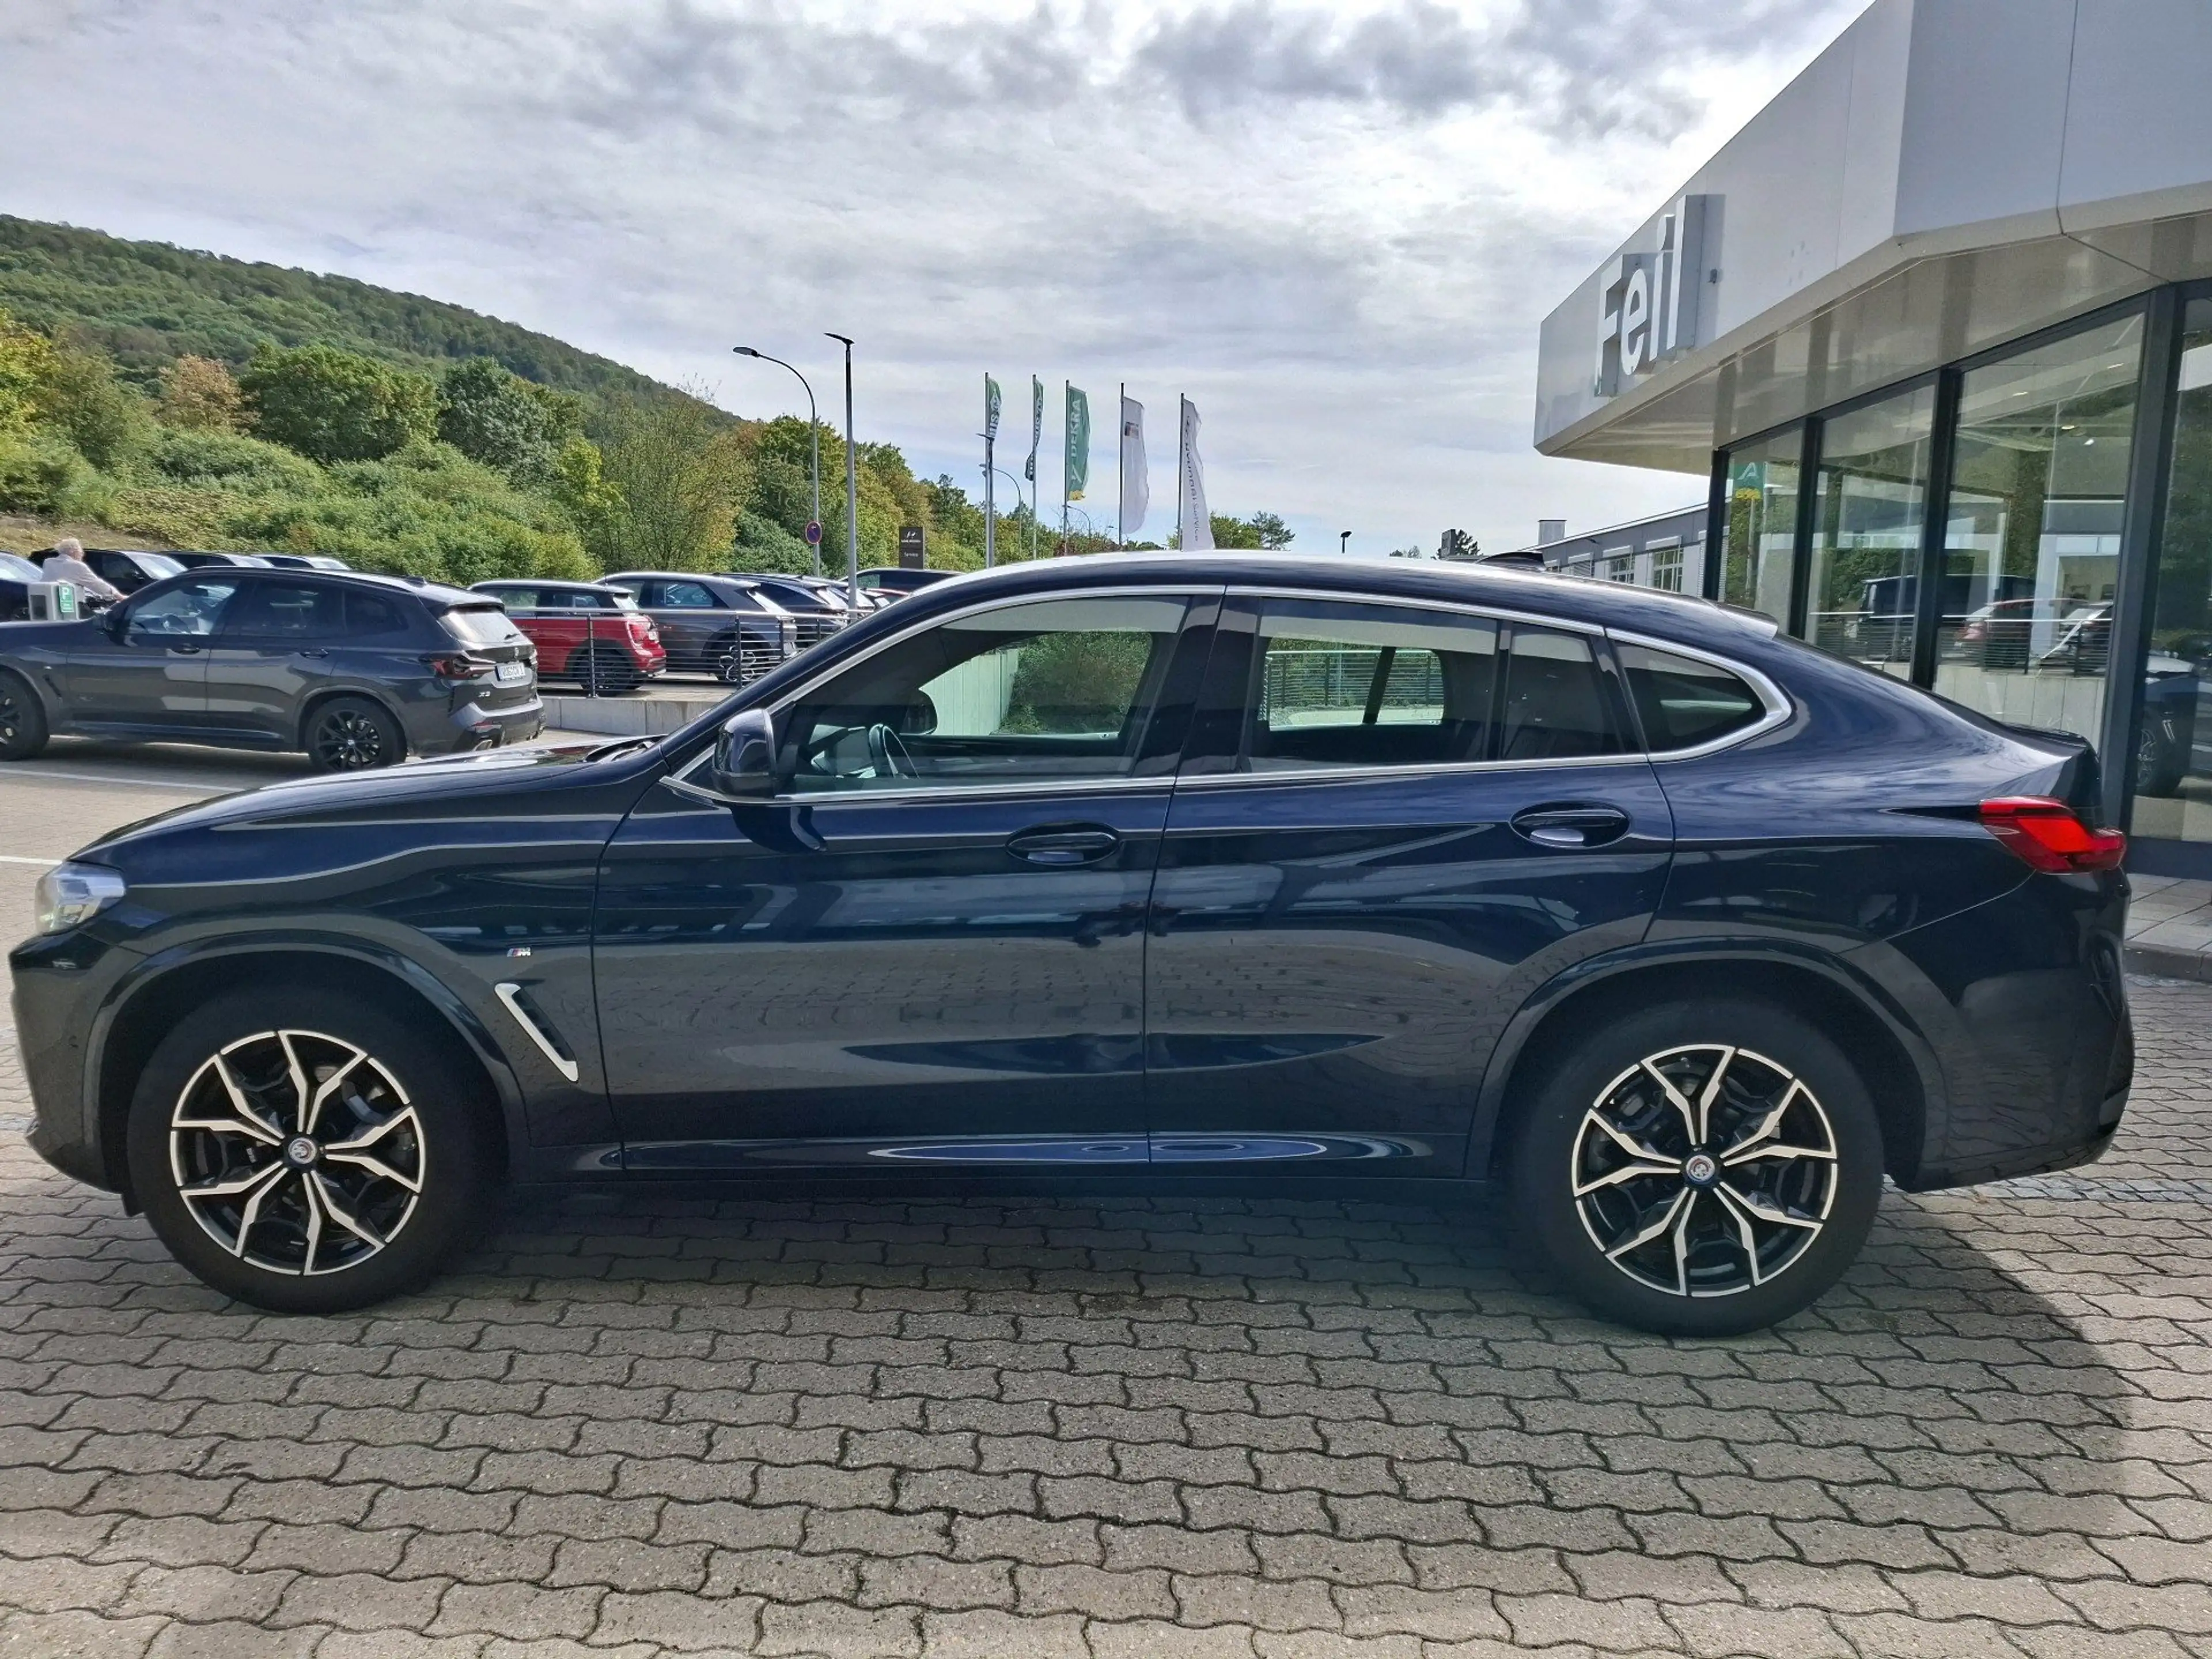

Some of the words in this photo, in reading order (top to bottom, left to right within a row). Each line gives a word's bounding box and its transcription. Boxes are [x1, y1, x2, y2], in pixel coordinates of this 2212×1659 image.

[1594, 195, 1689, 396] Feil
[1070, 399, 1081, 457] DEKRA
[62, 587, 70, 600] P
